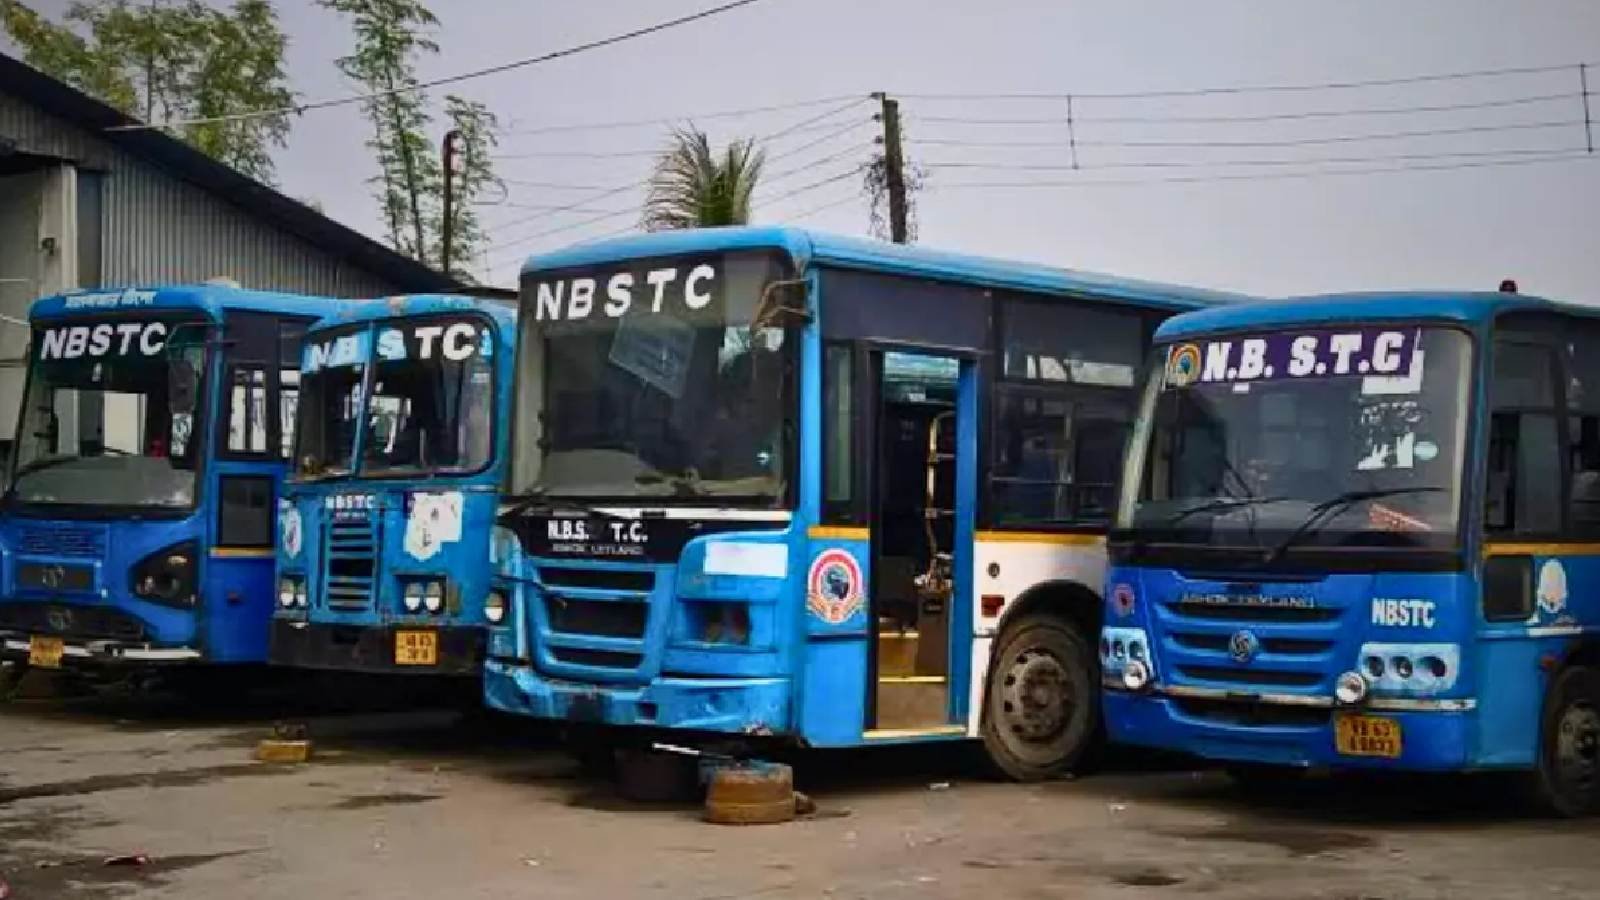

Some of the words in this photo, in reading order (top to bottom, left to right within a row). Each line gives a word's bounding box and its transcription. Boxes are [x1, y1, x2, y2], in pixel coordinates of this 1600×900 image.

[536, 264, 716, 321] NBSTC
[40, 322, 168, 360] NBSTC
[1201, 338, 1275, 382] N.B.
[1287, 330, 1405, 377] S.T.C
[325, 495, 376, 509] NBSTC
[547, 519, 590, 540] N.B.S.
[610, 520, 649, 543] T.C.
[1371, 597, 1437, 629] NBSTC
